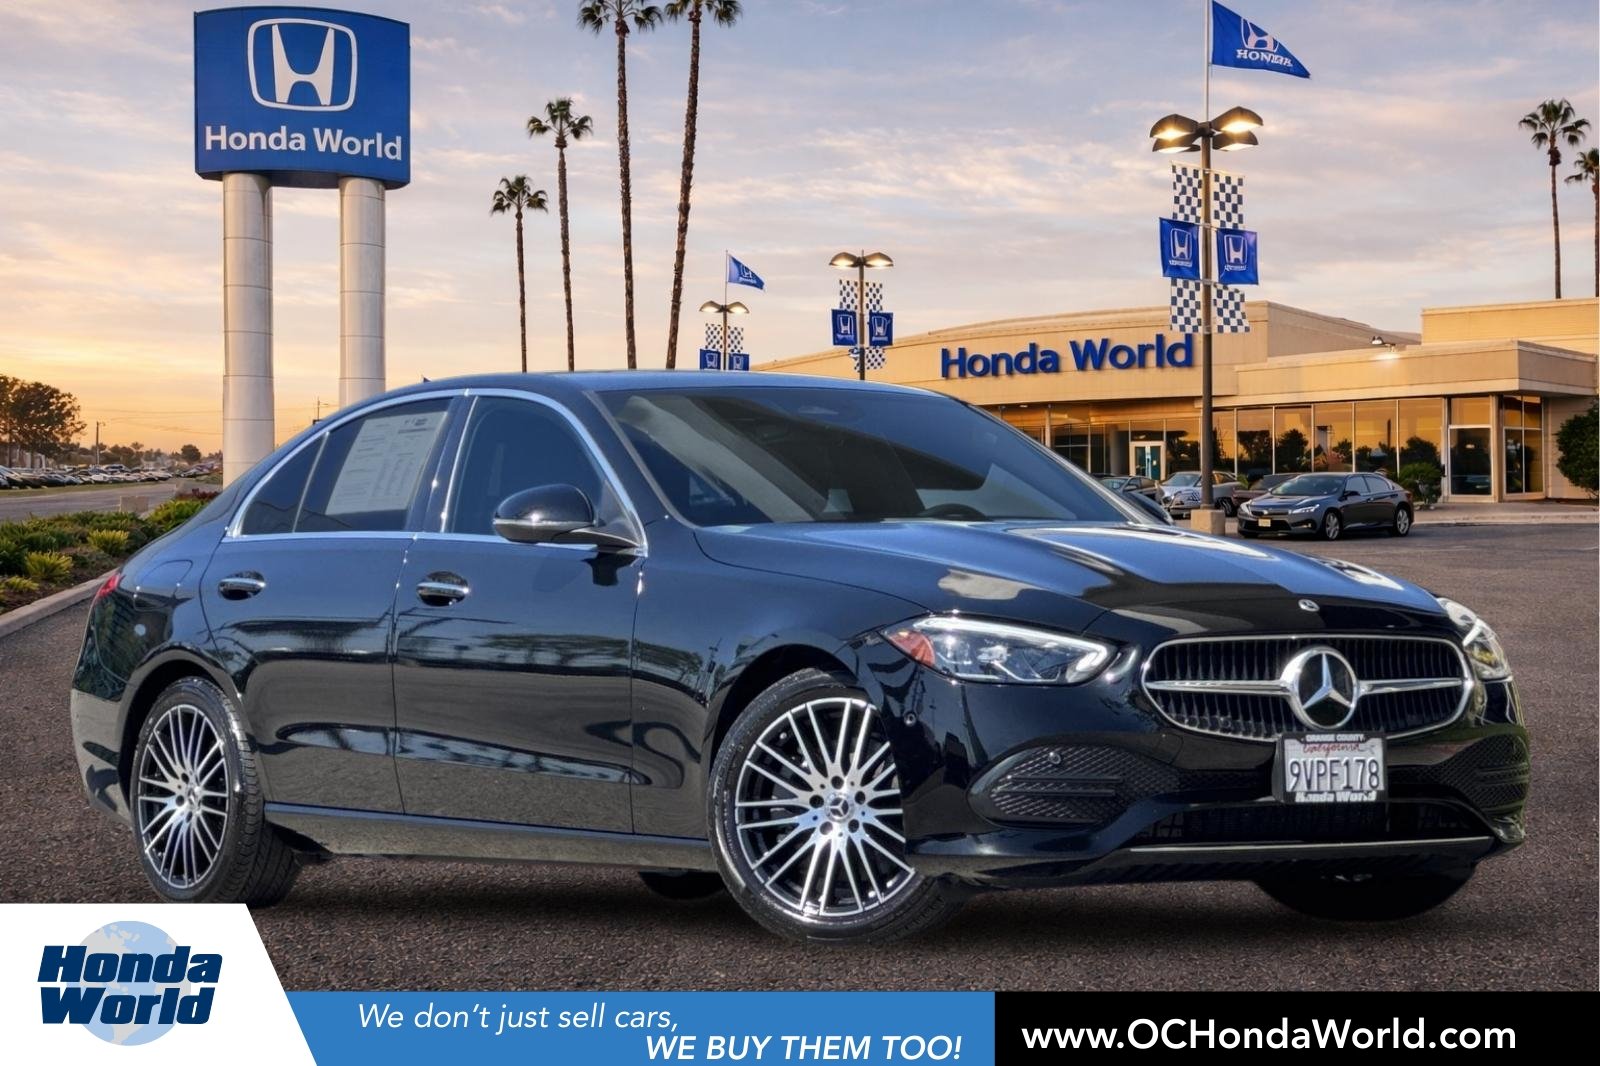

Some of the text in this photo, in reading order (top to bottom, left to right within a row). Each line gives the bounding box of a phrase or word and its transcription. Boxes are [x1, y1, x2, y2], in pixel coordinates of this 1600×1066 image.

[205, 125, 402, 160] Honda World
[941, 333, 1194, 379] Honda World
[1289, 758, 1380, 791] 9VPF178
